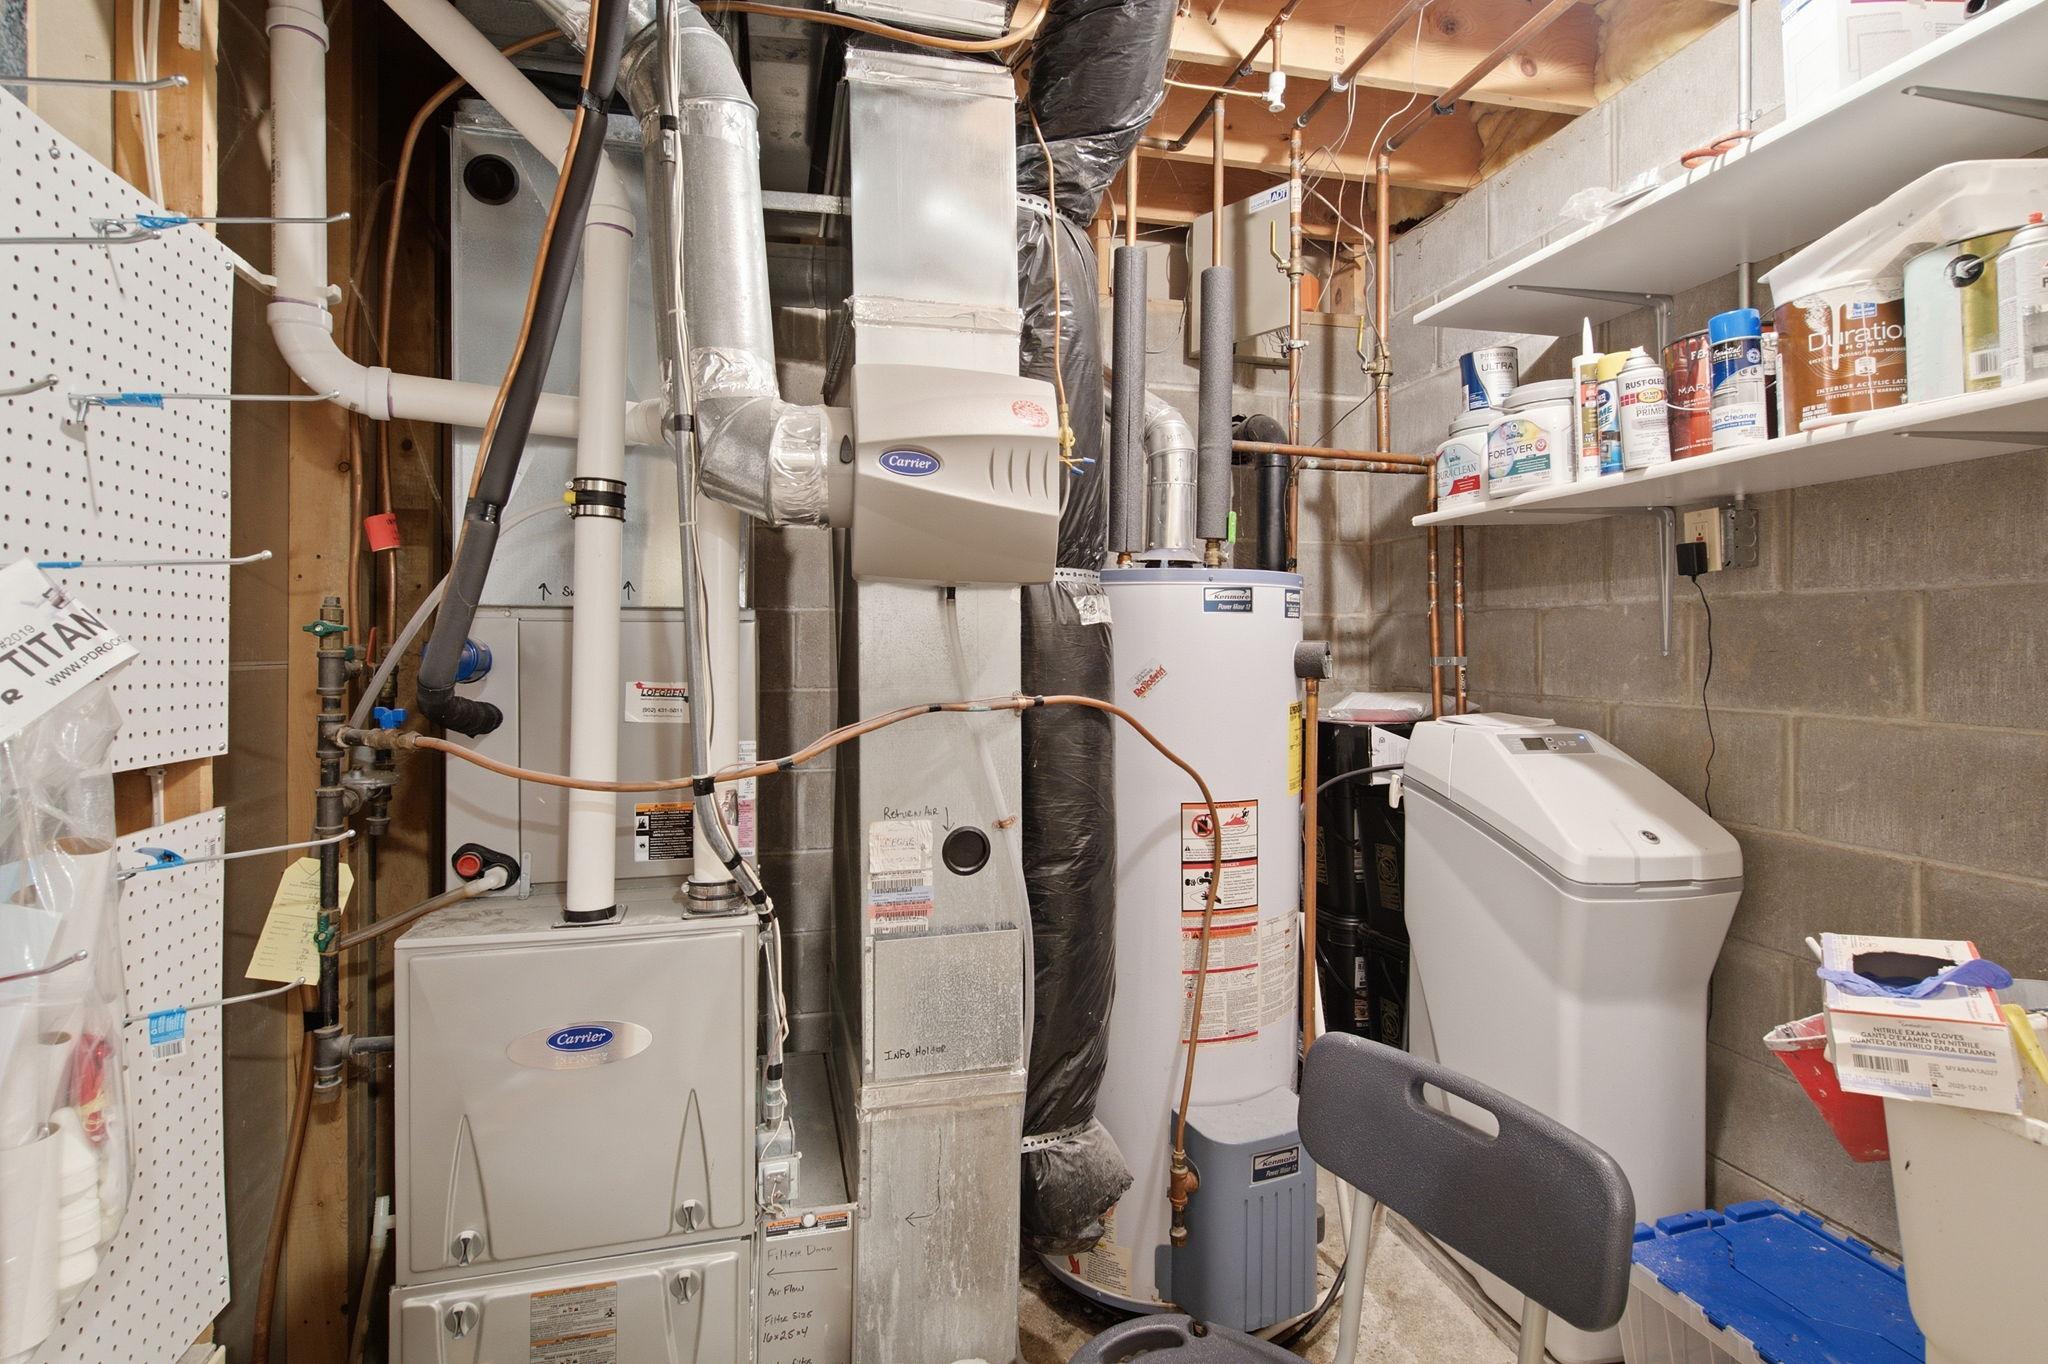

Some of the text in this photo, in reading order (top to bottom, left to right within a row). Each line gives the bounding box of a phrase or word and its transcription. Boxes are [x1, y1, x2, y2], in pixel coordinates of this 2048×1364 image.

[1481, 361, 1514, 371] ULTRA
[1816, 383, 1853, 395] INTERIOR
[1724, 412, 1757, 422] Cleaner
[1488, 443, 1533, 459] FOREVER
[888, 455, 932, 469] Carrier
[0, 608, 108, 677] TITAN
[640, 687, 686, 698] LOFGREN
[556, 1032, 606, 1046] Carrier
[1860, 1031, 1887, 1040] GANTS
[1948, 1039, 1980, 1049] NITRILE
[1873, 1026, 1964, 1041] NITRILE EXAM GLOVES
[1850, 1036, 1885, 1046] GUANTES
[1899, 1042, 1932, 1050] NITRILO
[1934, 1044, 1956, 1053] PARA
[1958, 1047, 1996, 1057] EXAMEN
[1262, 1155, 1297, 1167] Kenmore
